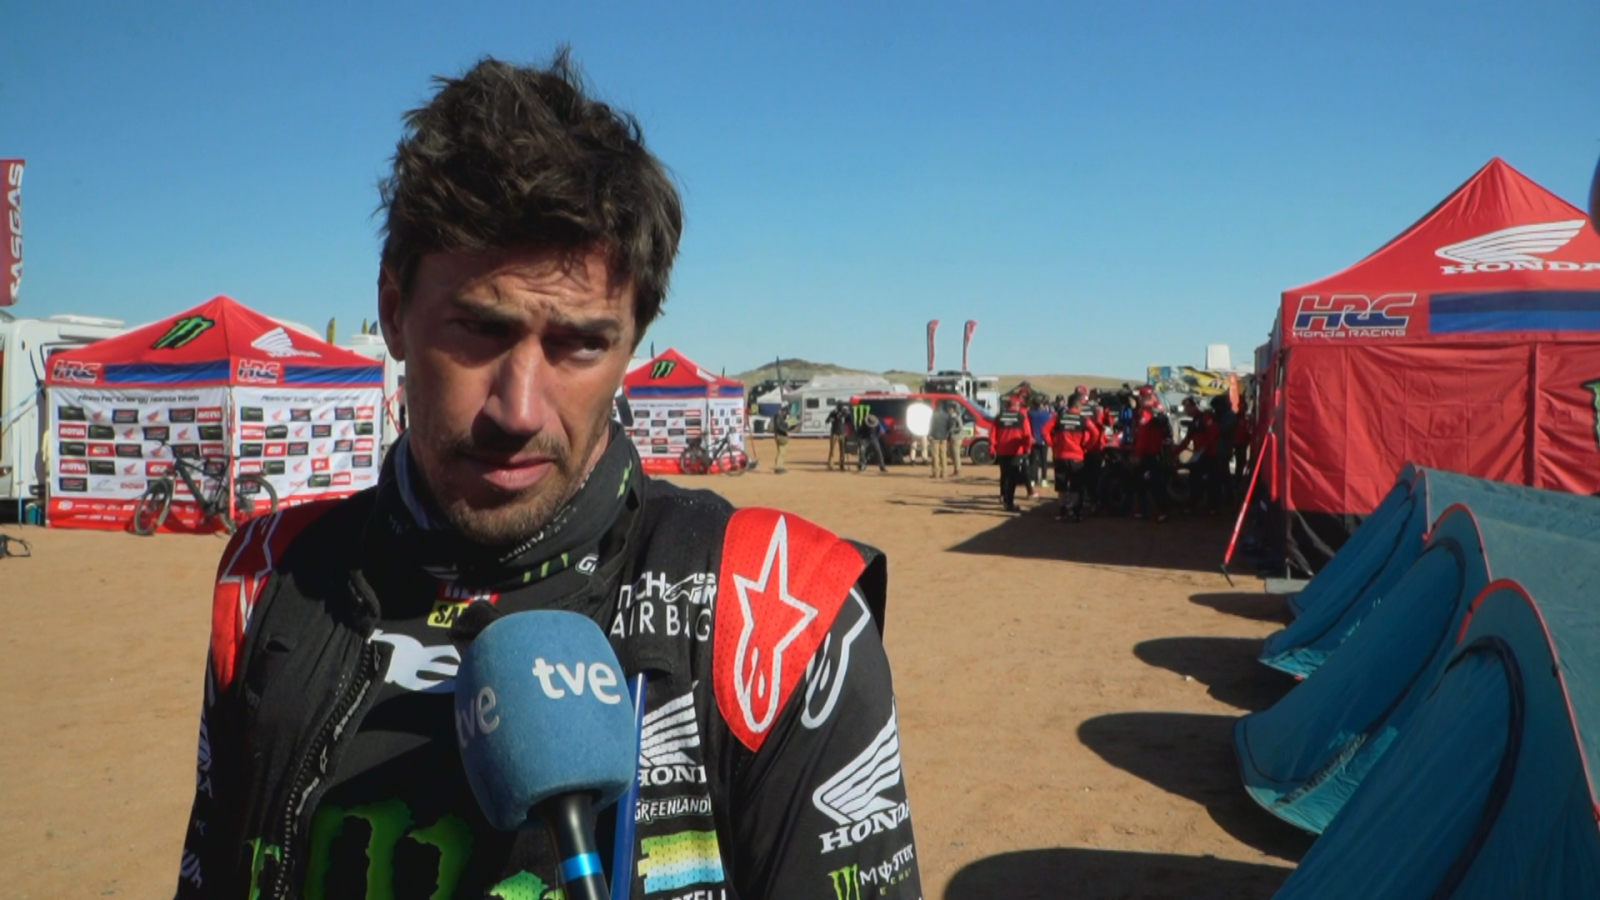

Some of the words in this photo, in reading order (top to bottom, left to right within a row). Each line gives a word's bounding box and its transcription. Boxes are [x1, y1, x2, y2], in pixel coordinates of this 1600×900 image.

[1440, 260, 1600, 275] HONDA
[1293, 293, 1417, 329] HRC
[1293, 330, 1346, 338] Honda
[1348, 329, 1406, 338] RACING
[532, 657, 622, 705] tve
[637, 764, 708, 787] HON
[634, 796, 713, 822] GREENLAND
